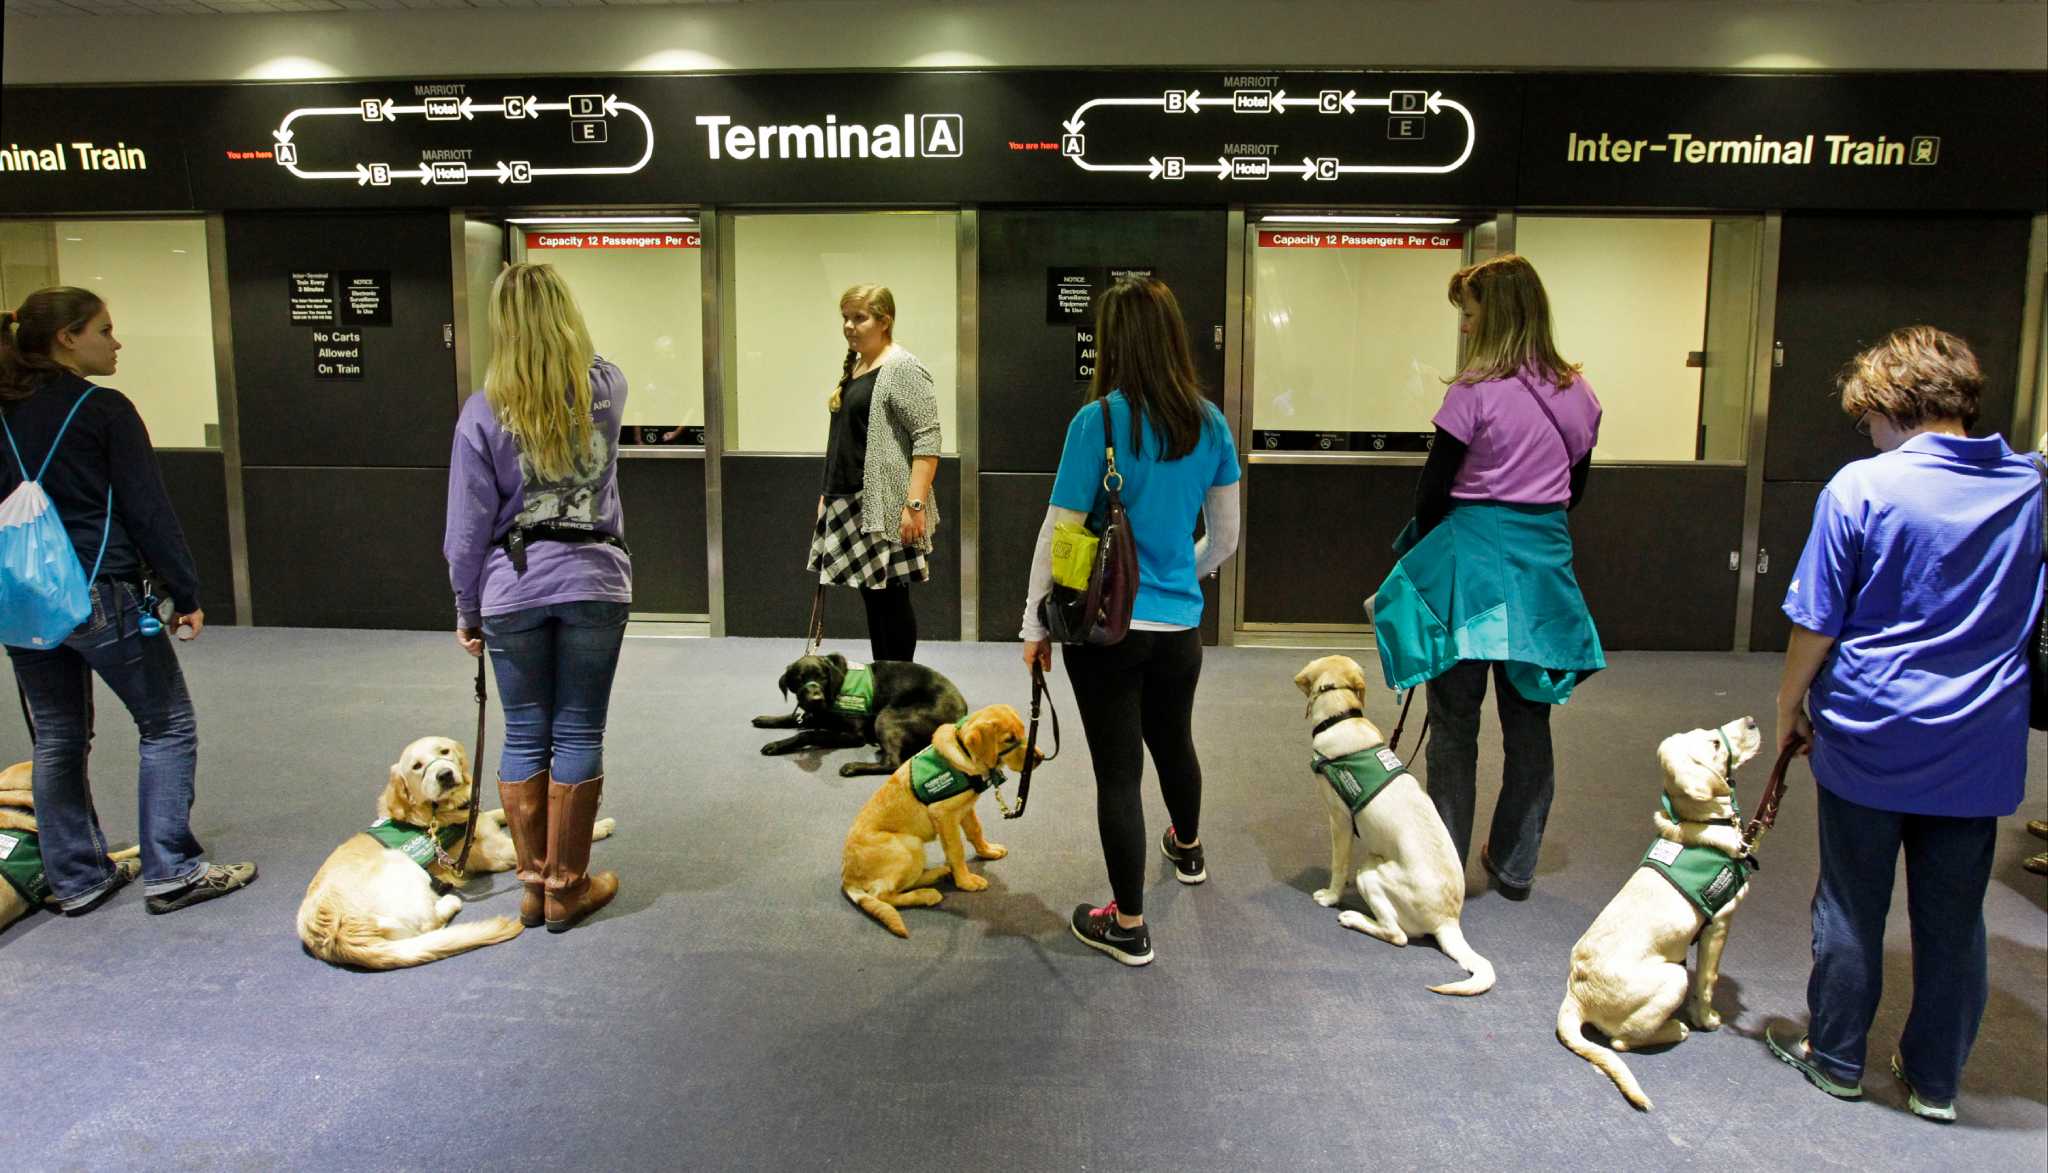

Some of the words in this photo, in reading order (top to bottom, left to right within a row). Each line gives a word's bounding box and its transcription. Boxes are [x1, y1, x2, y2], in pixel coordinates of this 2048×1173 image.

[1224, 76, 1280, 88] MARRIOTT
[414, 84, 466, 96] MARRIOTT
[428, 102, 458, 115] Hotel
[507, 100, 522, 115] C
[580, 98, 593, 114] D
[1168, 93, 1183, 110] B
[1237, 95, 1268, 108] Hotel
[1323, 94, 1338, 111] C
[1401, 95, 1417, 111] D
[365, 102, 380, 118] B
[583, 124, 595, 139] E
[1400, 120, 1413, 136] E
[695, 113, 915, 160] Terminal
[927, 119, 957, 152] A
[1008, 141, 1024, 150] You
[1025, 142, 1039, 150] are
[1040, 141, 1059, 150] here
[1066, 137, 1081, 153] A
[1224, 143, 1279, 155] MARRIOTT
[1566, 131, 1814, 165] Inter-Terminal
[1824, 134, 1904, 165] Train
[71, 141, 147, 171] Train
[226, 151, 241, 159] You
[255, 150, 273, 159] here
[279, 145, 293, 162] A
[422, 150, 472, 160] MARRIOTT
[373, 166, 387, 182] B
[435, 166, 465, 179] Hotel
[514, 164, 528, 180] C
[1167, 160, 1181, 177] B
[1235, 162, 1266, 176] Hotel
[1320, 161, 1335, 177] C
[538, 236, 583, 247] Capacity
[588, 236, 599, 245] 12
[602, 236, 661, 247] Passengers
[665, 236, 682, 245] Per
[686, 236, 701, 245] Ca
[1272, 234, 1320, 246] Capacity
[1325, 235, 1337, 244] 12
[1341, 235, 1404, 247] Passengers
[1408, 236, 1426, 246] Per
[1431, 236, 1450, 246] Car
[313, 332, 329, 342] No
[332, 332, 360, 342] Carts
[1077, 332, 1093, 342] No
[318, 348, 358, 358] Allowed
[1081, 348, 1098, 358] All
[318, 364, 333, 374] On
[336, 364, 360, 374] Train
[1079, 365, 1096, 375] On
